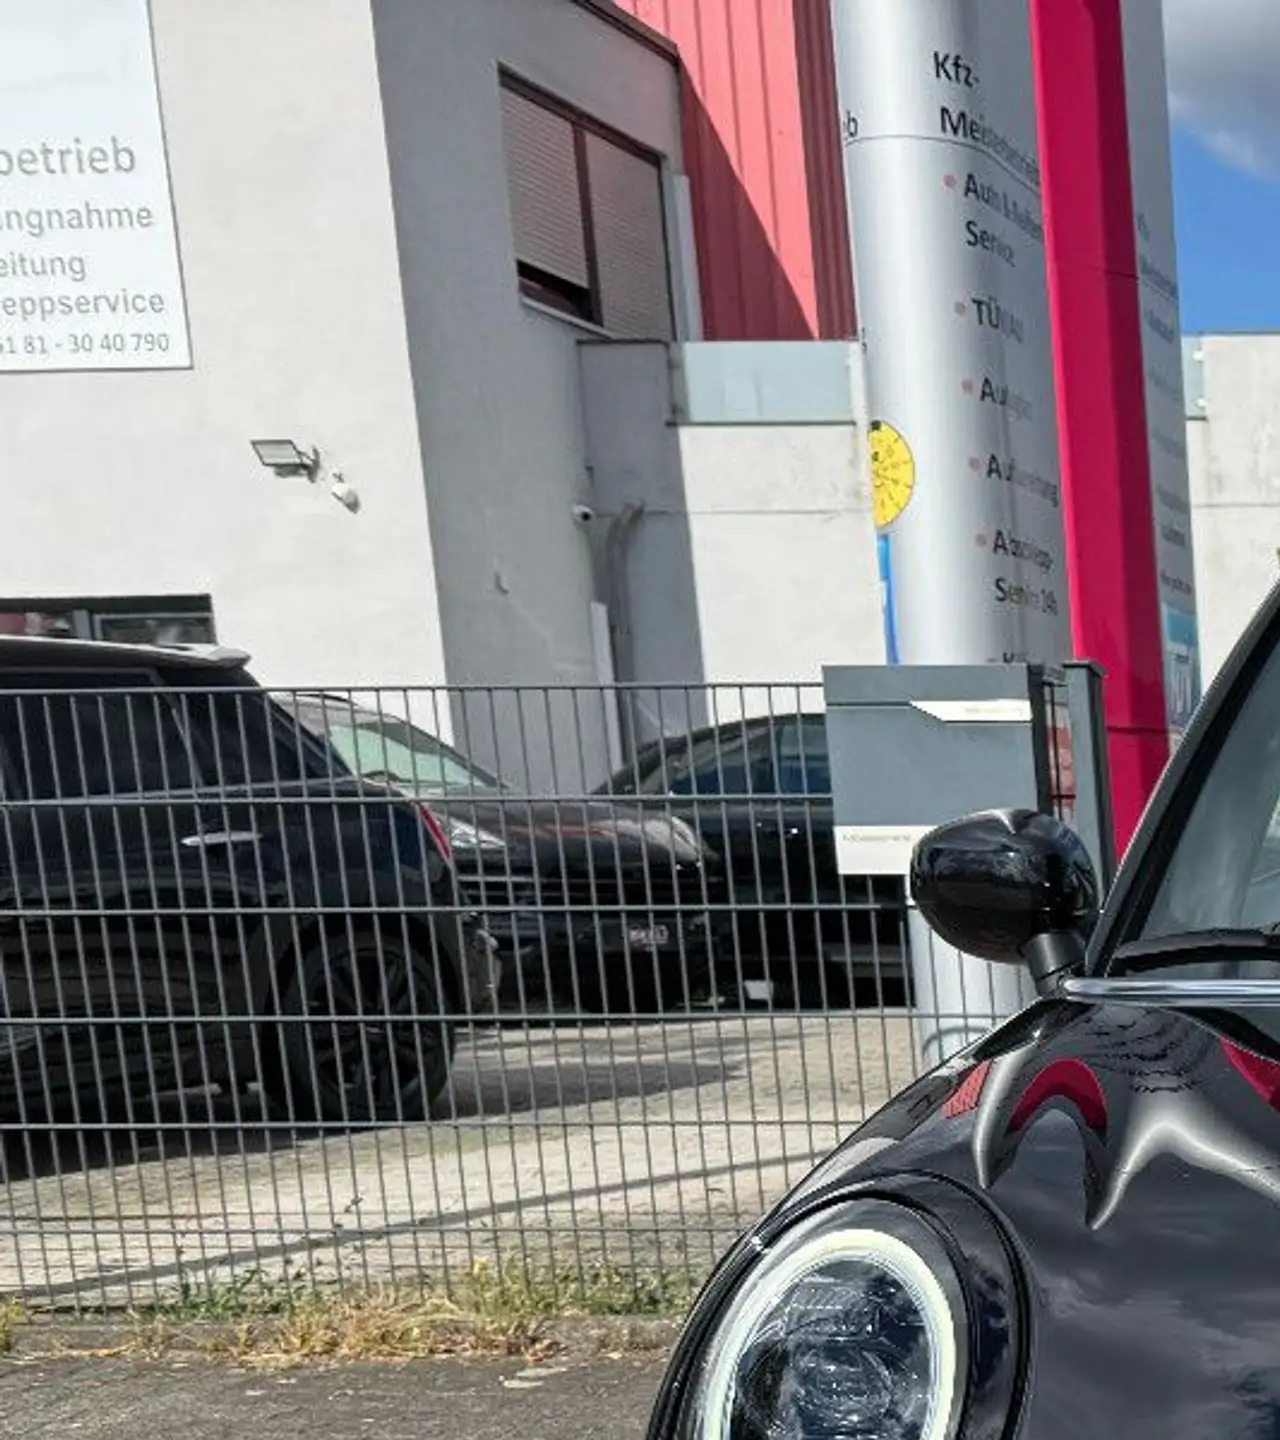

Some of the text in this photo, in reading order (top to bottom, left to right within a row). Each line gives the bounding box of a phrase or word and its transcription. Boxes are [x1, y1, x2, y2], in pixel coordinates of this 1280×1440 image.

[933, 50, 980, 88] Kfz-
[0, 199, 154, 238] ngnahme
[23, 334, 49, 355] 81
[67, 333, 94, 352] 30
[100, 333, 125, 352] 40
[130, 333, 170, 352] 790
